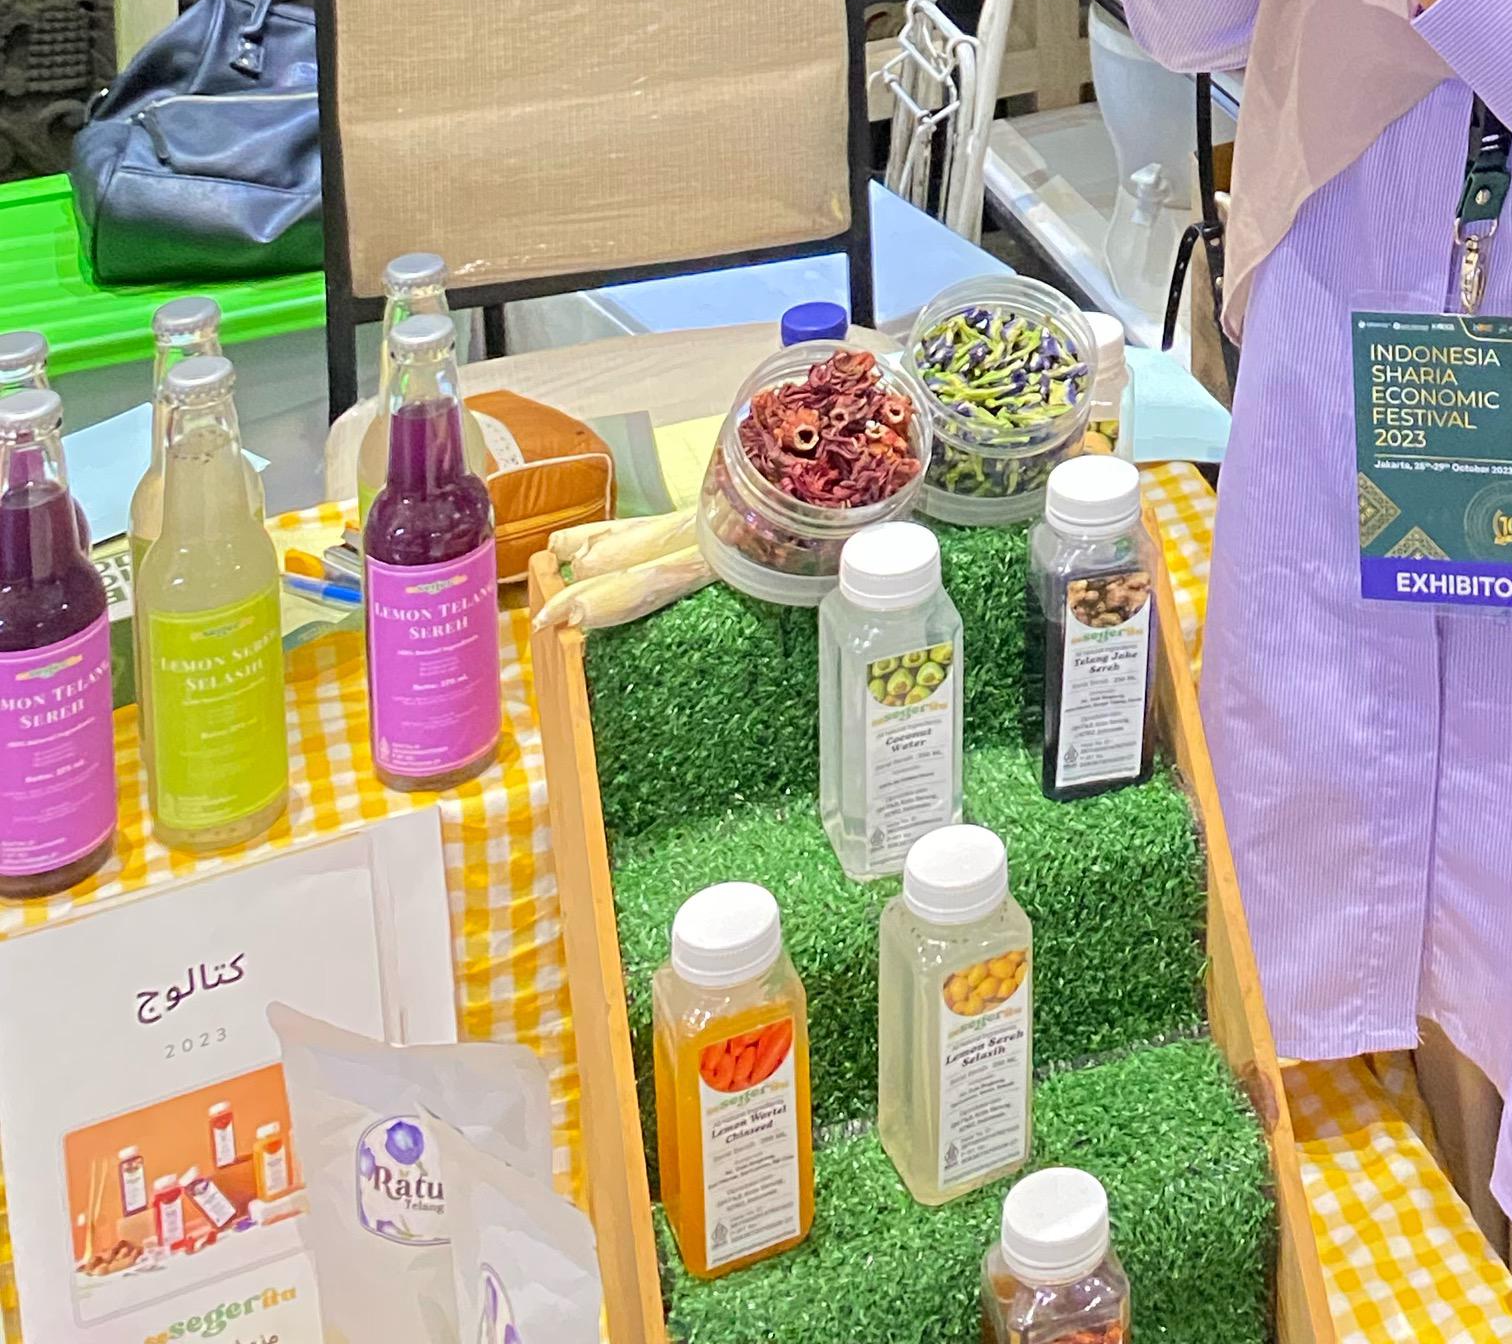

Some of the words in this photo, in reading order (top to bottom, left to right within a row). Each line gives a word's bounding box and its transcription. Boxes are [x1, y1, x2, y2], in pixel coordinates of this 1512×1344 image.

[1370, 344, 1500, 367] INDONESIA
[1372, 365, 1458, 385] SHARIA
[1372, 386, 1500, 409] ECONOMIC
[1372, 407, 1477, 430] FESTIVAL
[1374, 429, 1427, 448] 2023
[374, 601, 433, 622] LEMON
[408, 615, 468, 640] SEREH
[0, 693, 46, 711] MON
[136, 953, 247, 1024] كتالوج
[165, 1027, 229, 1060] 2023
[373, 1165, 445, 1203] Ratu
